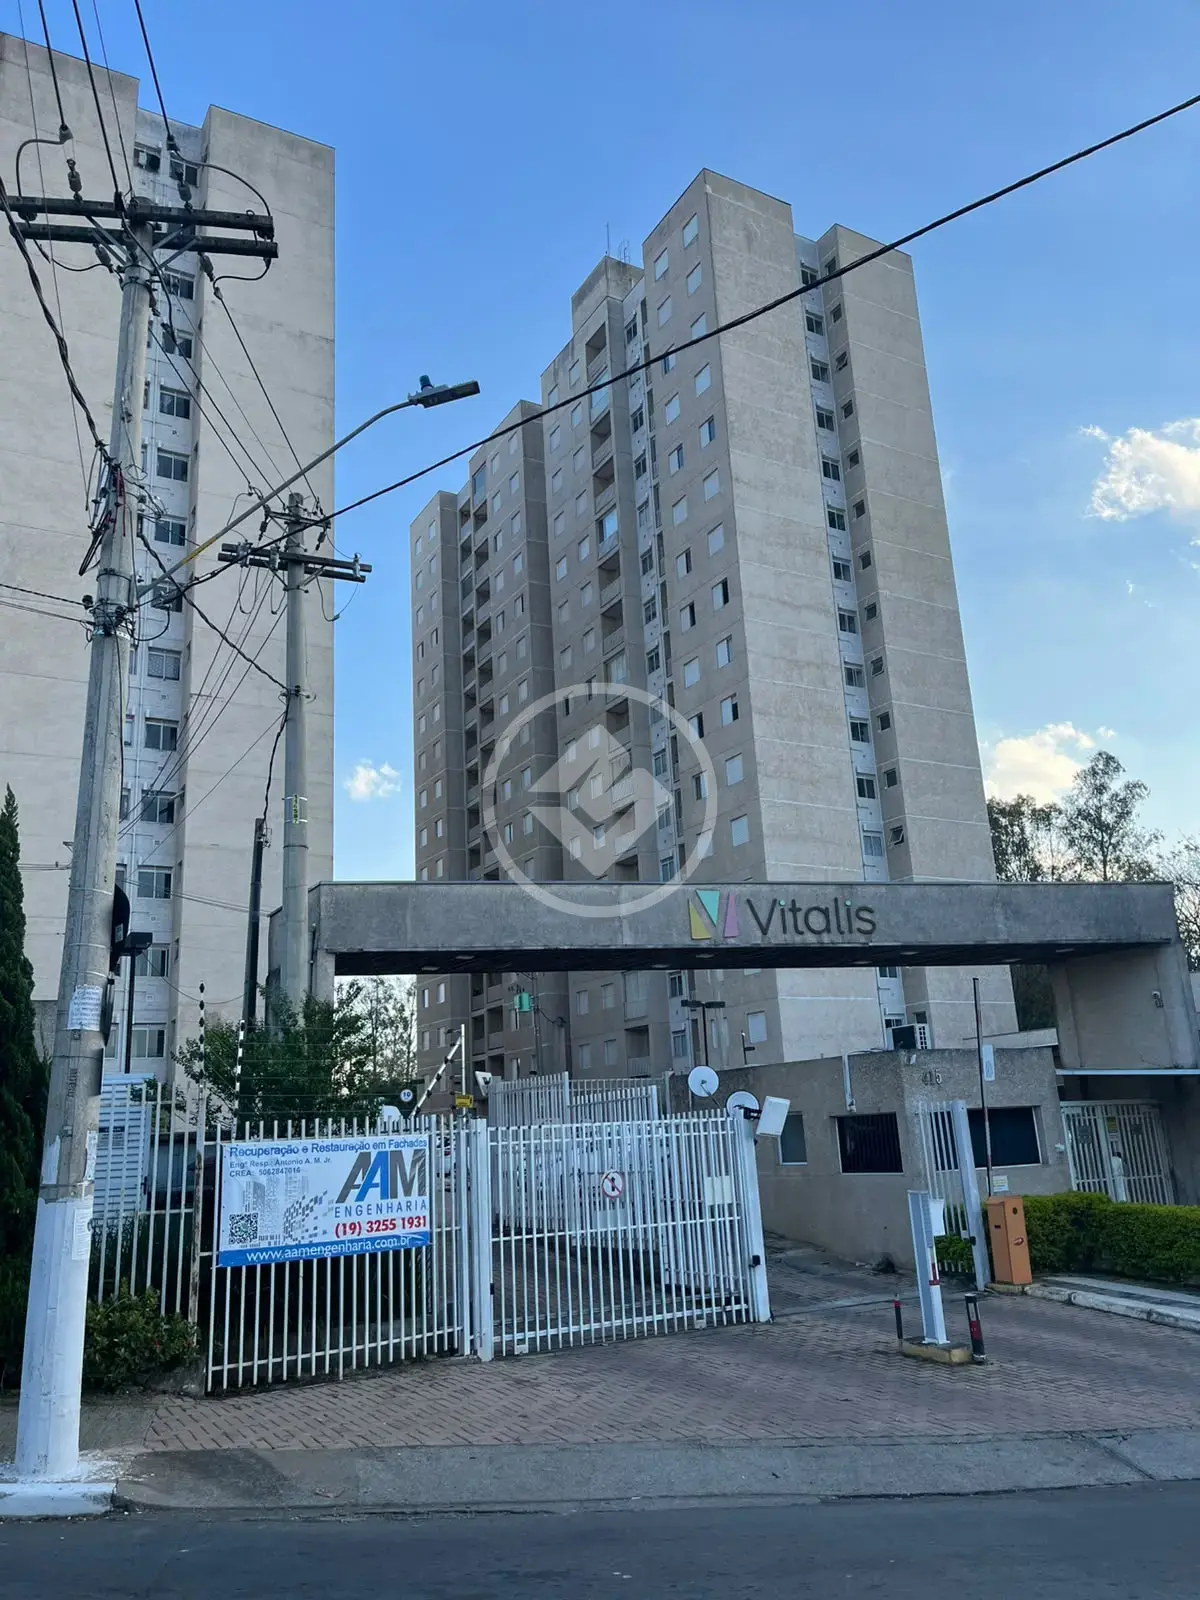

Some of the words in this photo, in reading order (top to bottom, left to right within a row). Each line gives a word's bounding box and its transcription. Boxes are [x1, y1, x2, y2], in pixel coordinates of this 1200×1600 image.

[746, 896, 876, 935] Vitalis
[230, 1144, 299, 1158] Recuperação
[301, 1145, 308, 1153] e
[311, 1140, 370, 1154] Restauração
[372, 1141, 386, 1150] em
[274, 1158, 303, 1166] Antonio
[229, 1169, 255, 1178] CREA:
[335, 1149, 427, 1204] AAM
[334, 1199, 428, 1219] ENGENHARIA
[335, 1221, 362, 1239] (19)
[366, 1218, 397, 1233] 3255
[401, 1215, 427, 1230] 1931
[246, 1235, 410, 1262] www.aamengenharia.com.br
